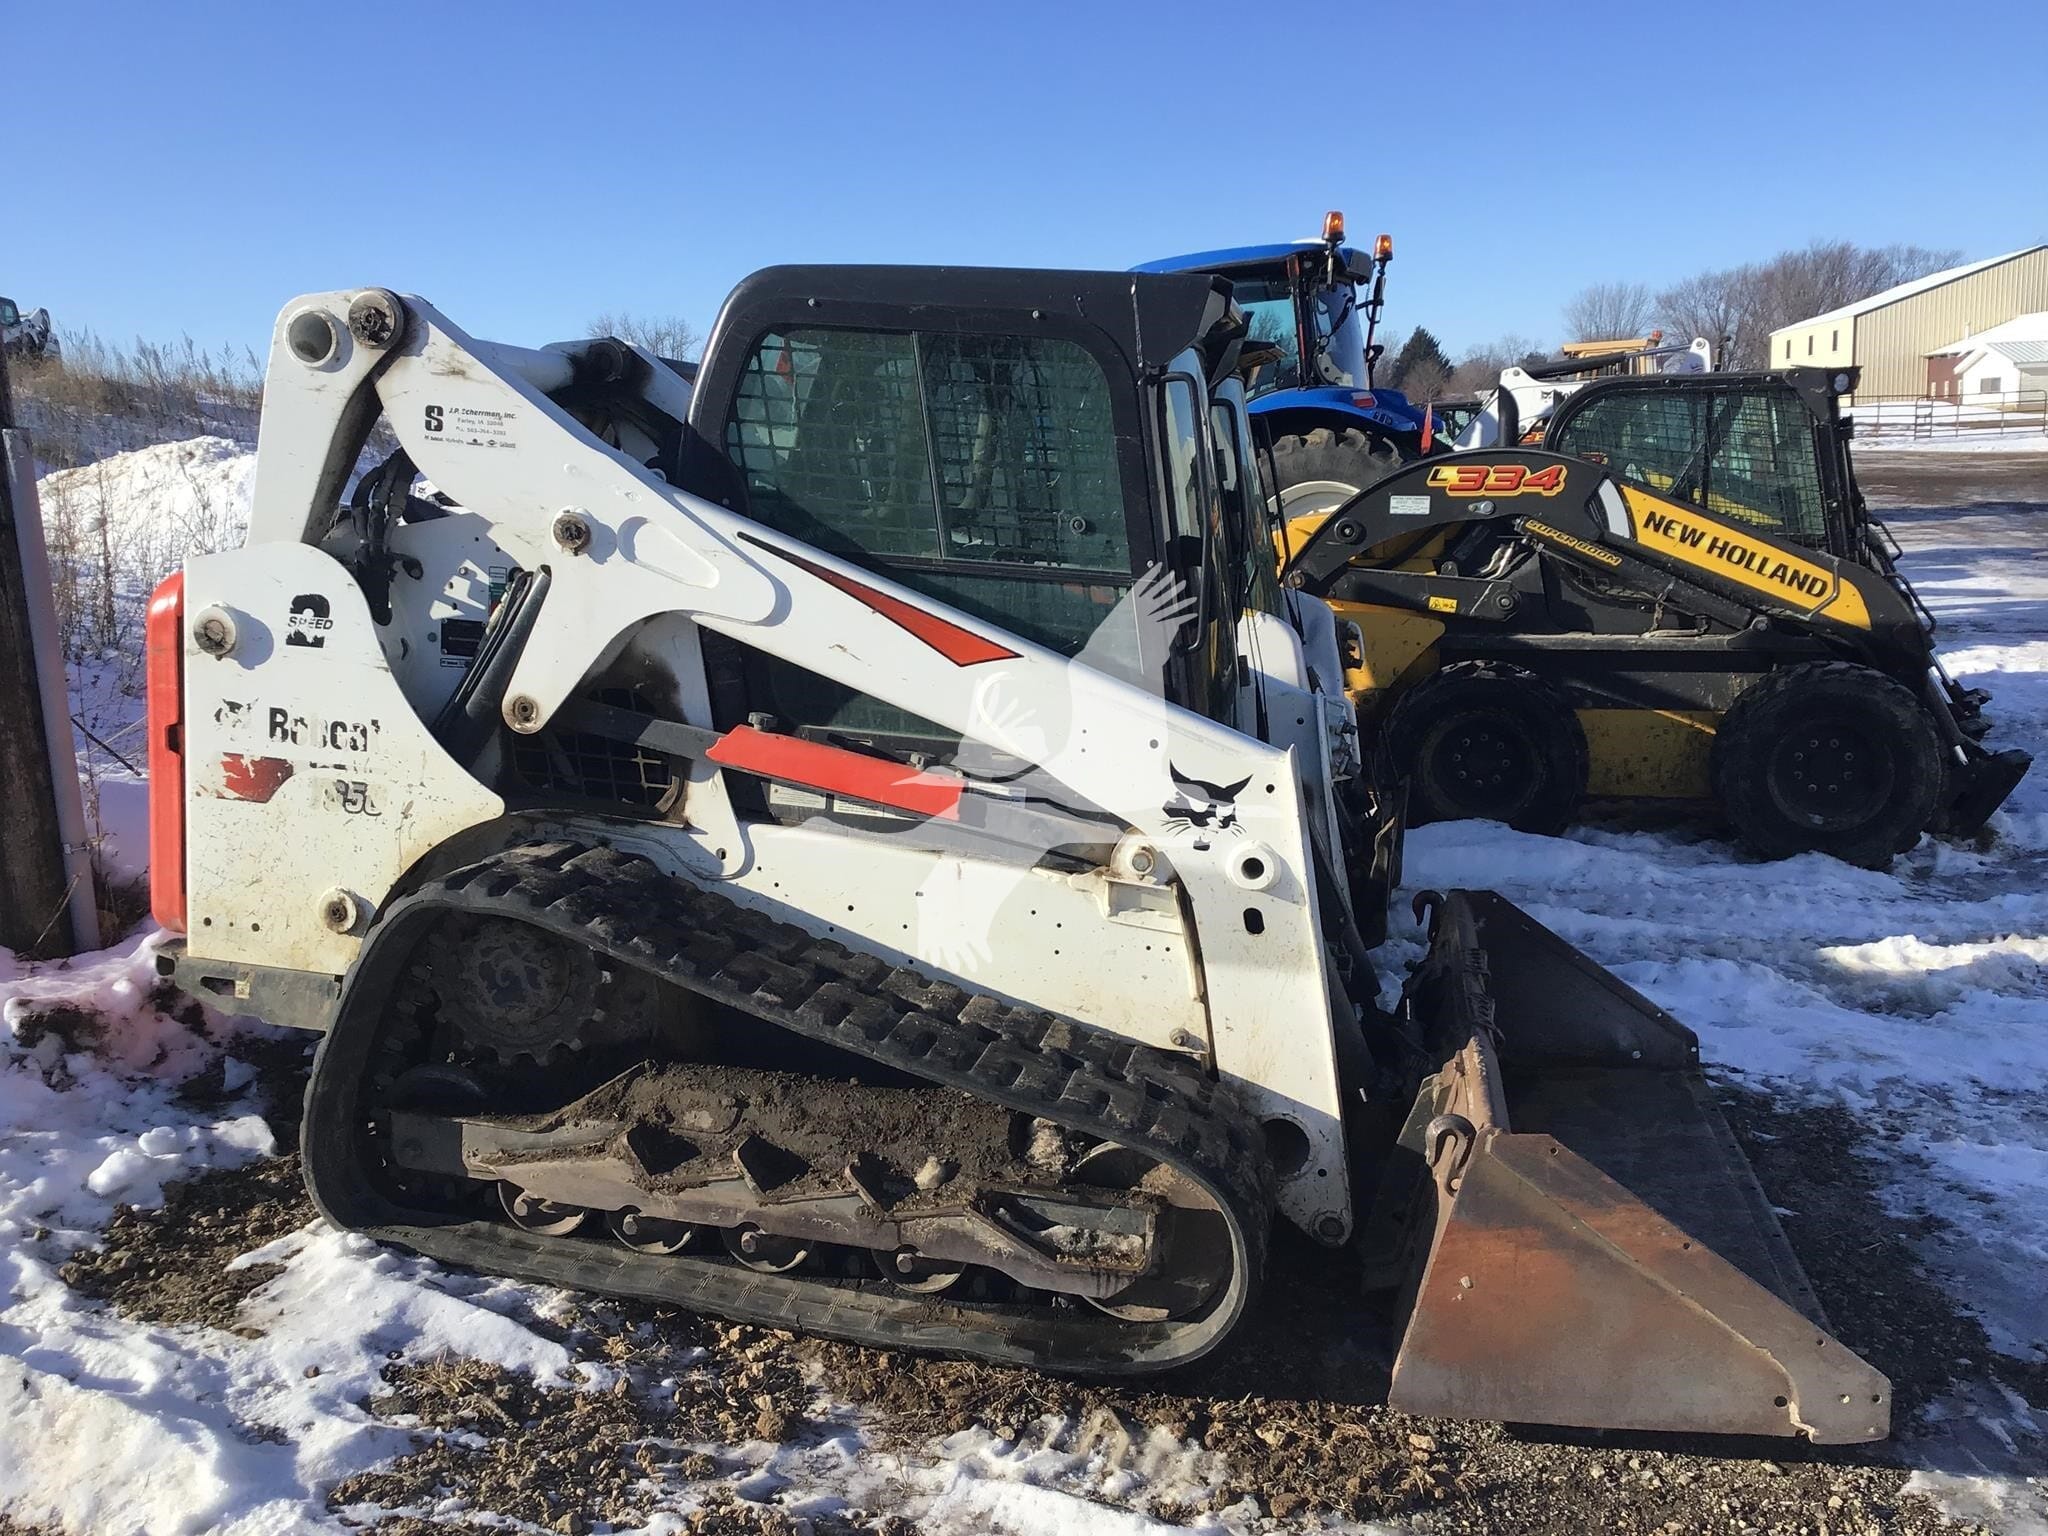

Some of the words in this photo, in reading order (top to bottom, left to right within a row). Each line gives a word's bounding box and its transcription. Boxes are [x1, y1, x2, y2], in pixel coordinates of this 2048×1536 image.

[1525, 519, 1578, 547] SUPER
[1576, 540, 1623, 567] BOOM
[1643, 510, 1706, 548] NEW
[1707, 536, 1829, 598] HOLLAND
